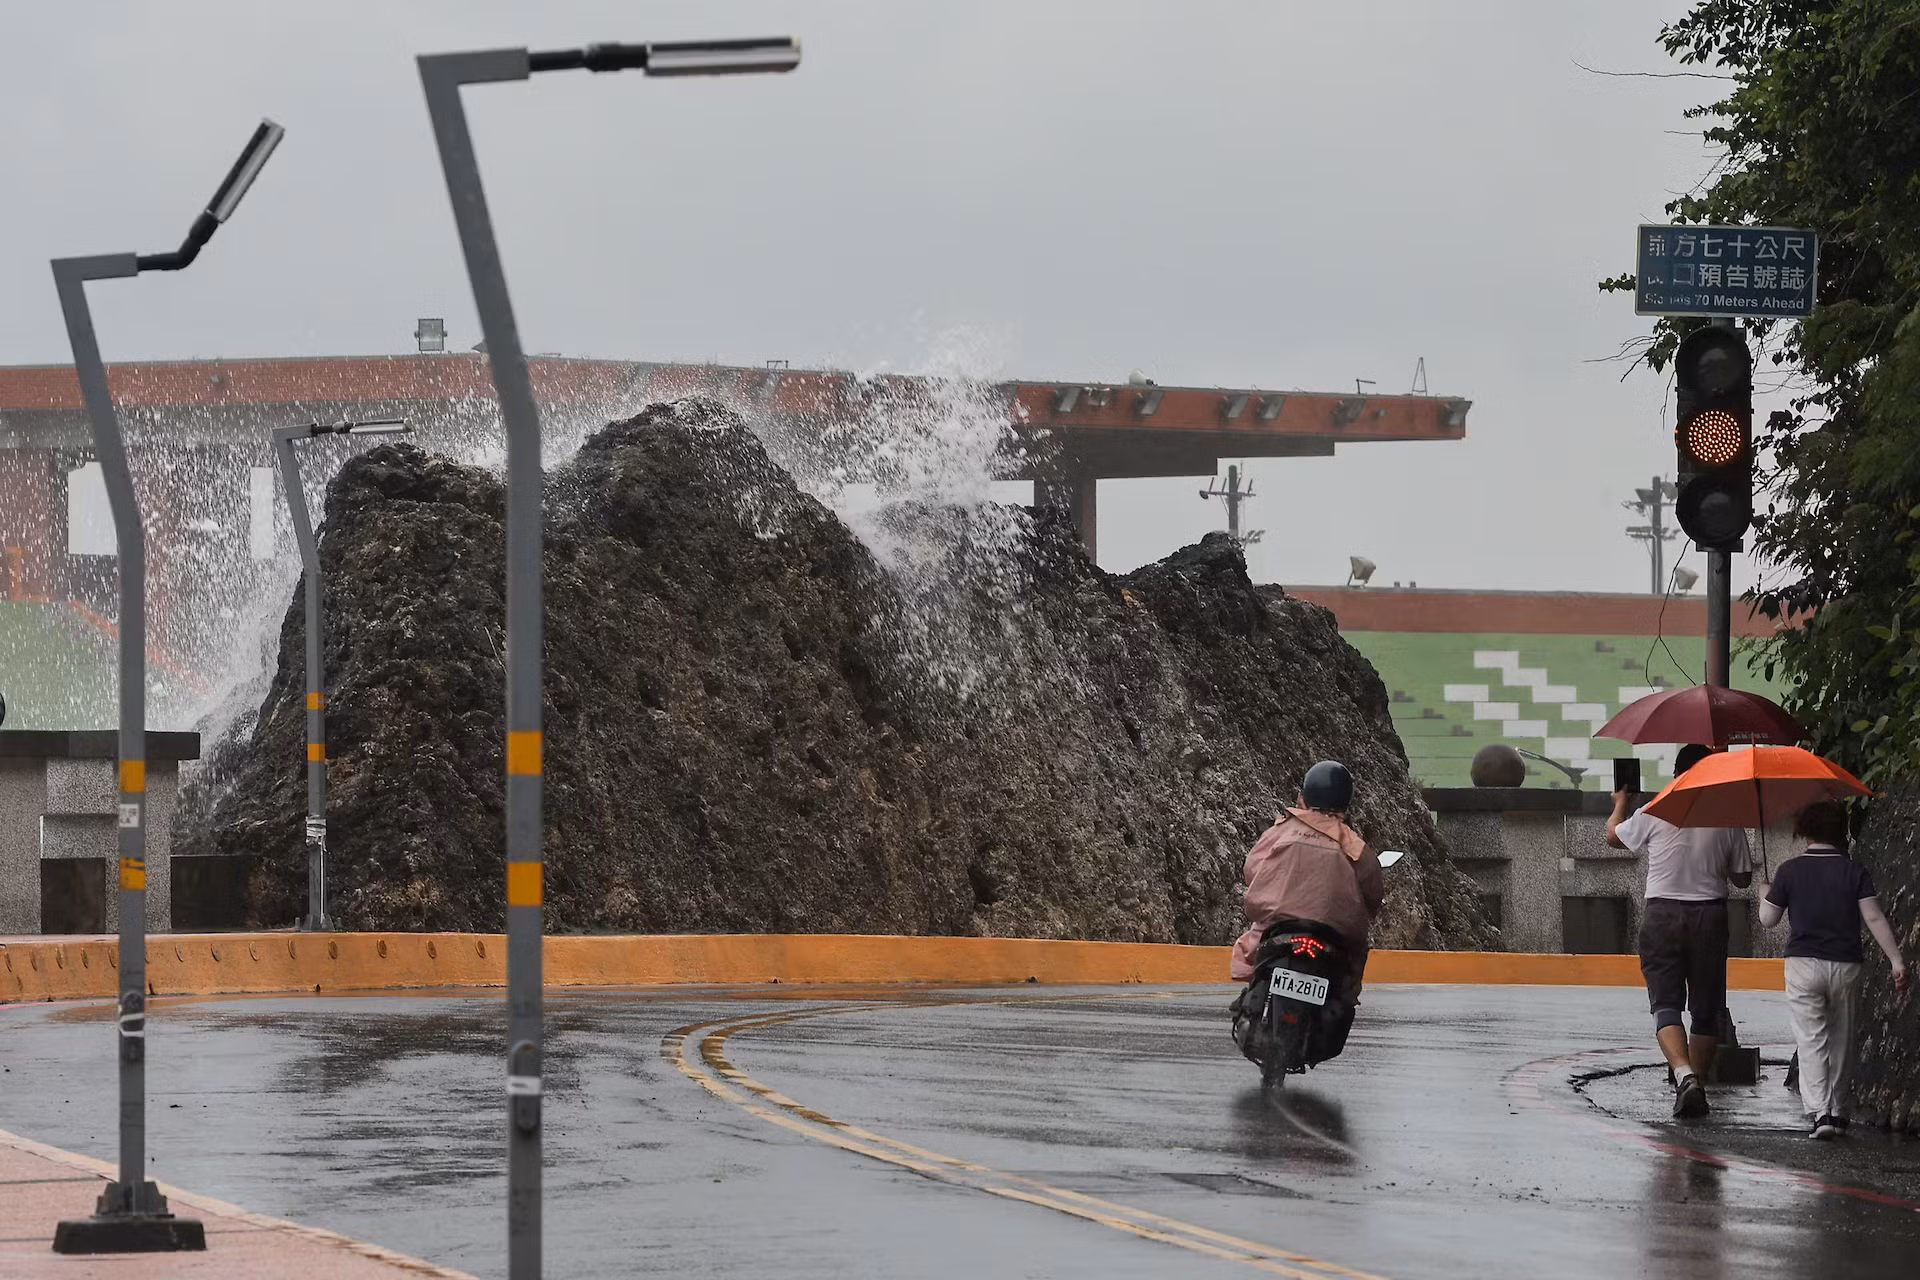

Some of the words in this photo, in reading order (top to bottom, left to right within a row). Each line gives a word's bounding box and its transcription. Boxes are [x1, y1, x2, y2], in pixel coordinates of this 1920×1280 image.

[1647, 263, 1806, 290] 口預告號誌
[1694, 294, 1710, 306] 70
[1713, 294, 1759, 307] Meters
[1761, 296, 1805, 309] Ahead
